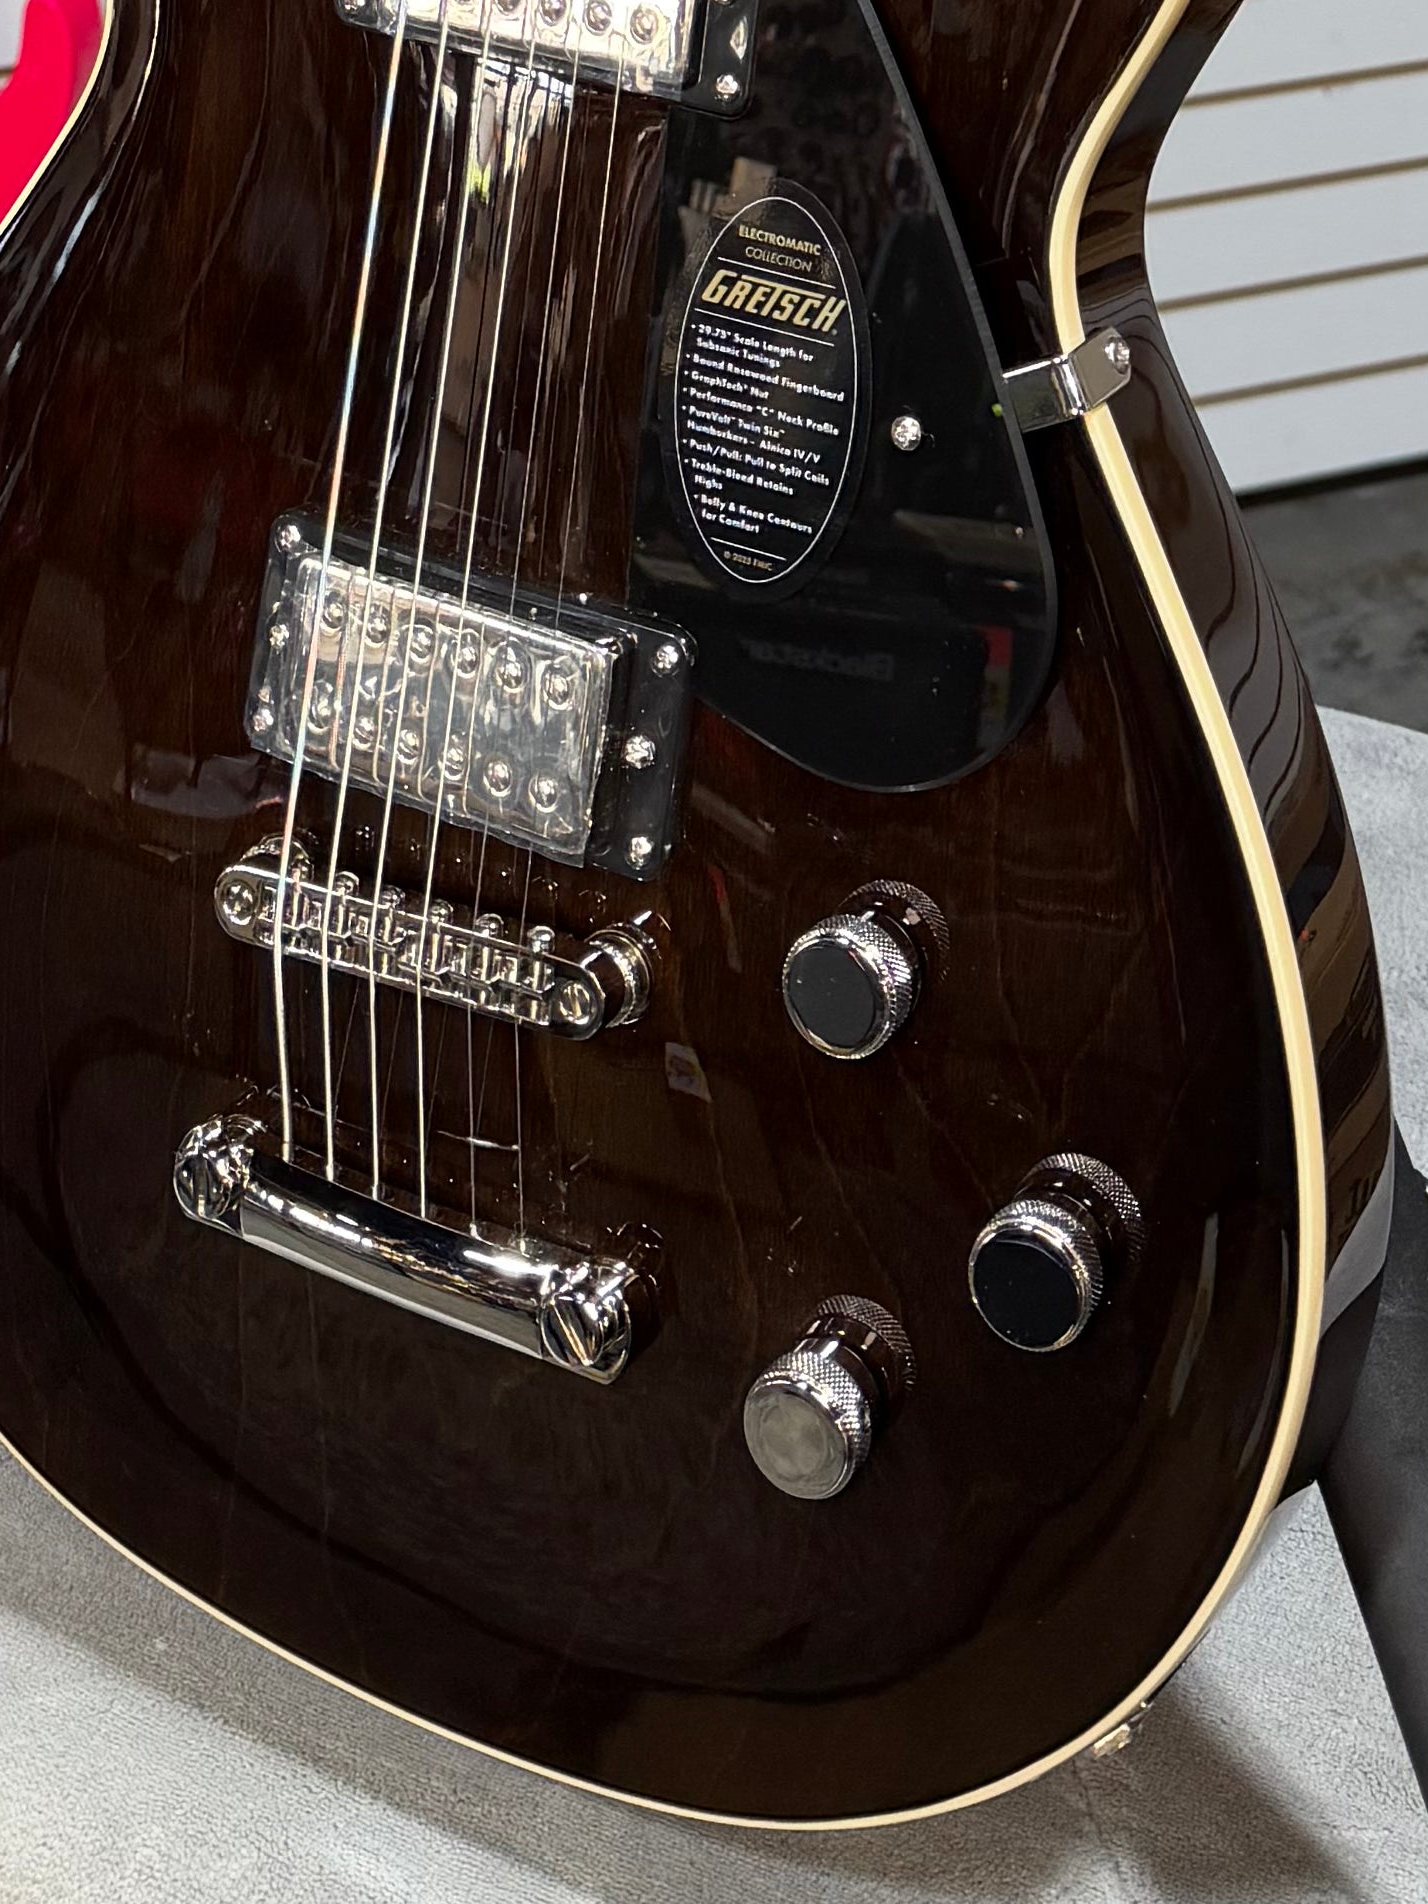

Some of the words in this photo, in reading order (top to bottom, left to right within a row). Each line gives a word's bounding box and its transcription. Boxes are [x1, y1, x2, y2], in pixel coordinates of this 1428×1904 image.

[738, 224, 822, 256] ELECTROMATIC
[745, 246, 813, 273] COLLECTION
[701, 269, 847, 333] GRETSCH
[733, 333, 760, 348] Scale
[762, 340, 797, 358] Length
[798, 349, 814, 362] for
[742, 349, 781, 369] Tunings
[693, 353, 725, 371] Bound
[727, 363, 780, 385] Rosewood
[781, 376, 845, 403] Fingerboard
[750, 386, 770, 399] Nut
[689, 387, 753, 413] Performance
[777, 410, 803, 428] Neck
[806, 418, 840, 436] Profile
[738, 418, 761, 433] Twin
[793, 448, 821, 465] IV/V
[694, 474, 723, 491] Highs
[744, 454, 764, 468] Pull
[766, 461, 777, 471] to
[778, 463, 802, 479] Split
[804, 470, 830, 487] Coils
[756, 475, 794, 496] Retains
[701, 508, 717, 522] for
[719, 514, 760, 534] Comfort
[728, 502, 736, 513] &
[739, 504, 764, 521] Knee
[767, 512, 813, 535] Contours
